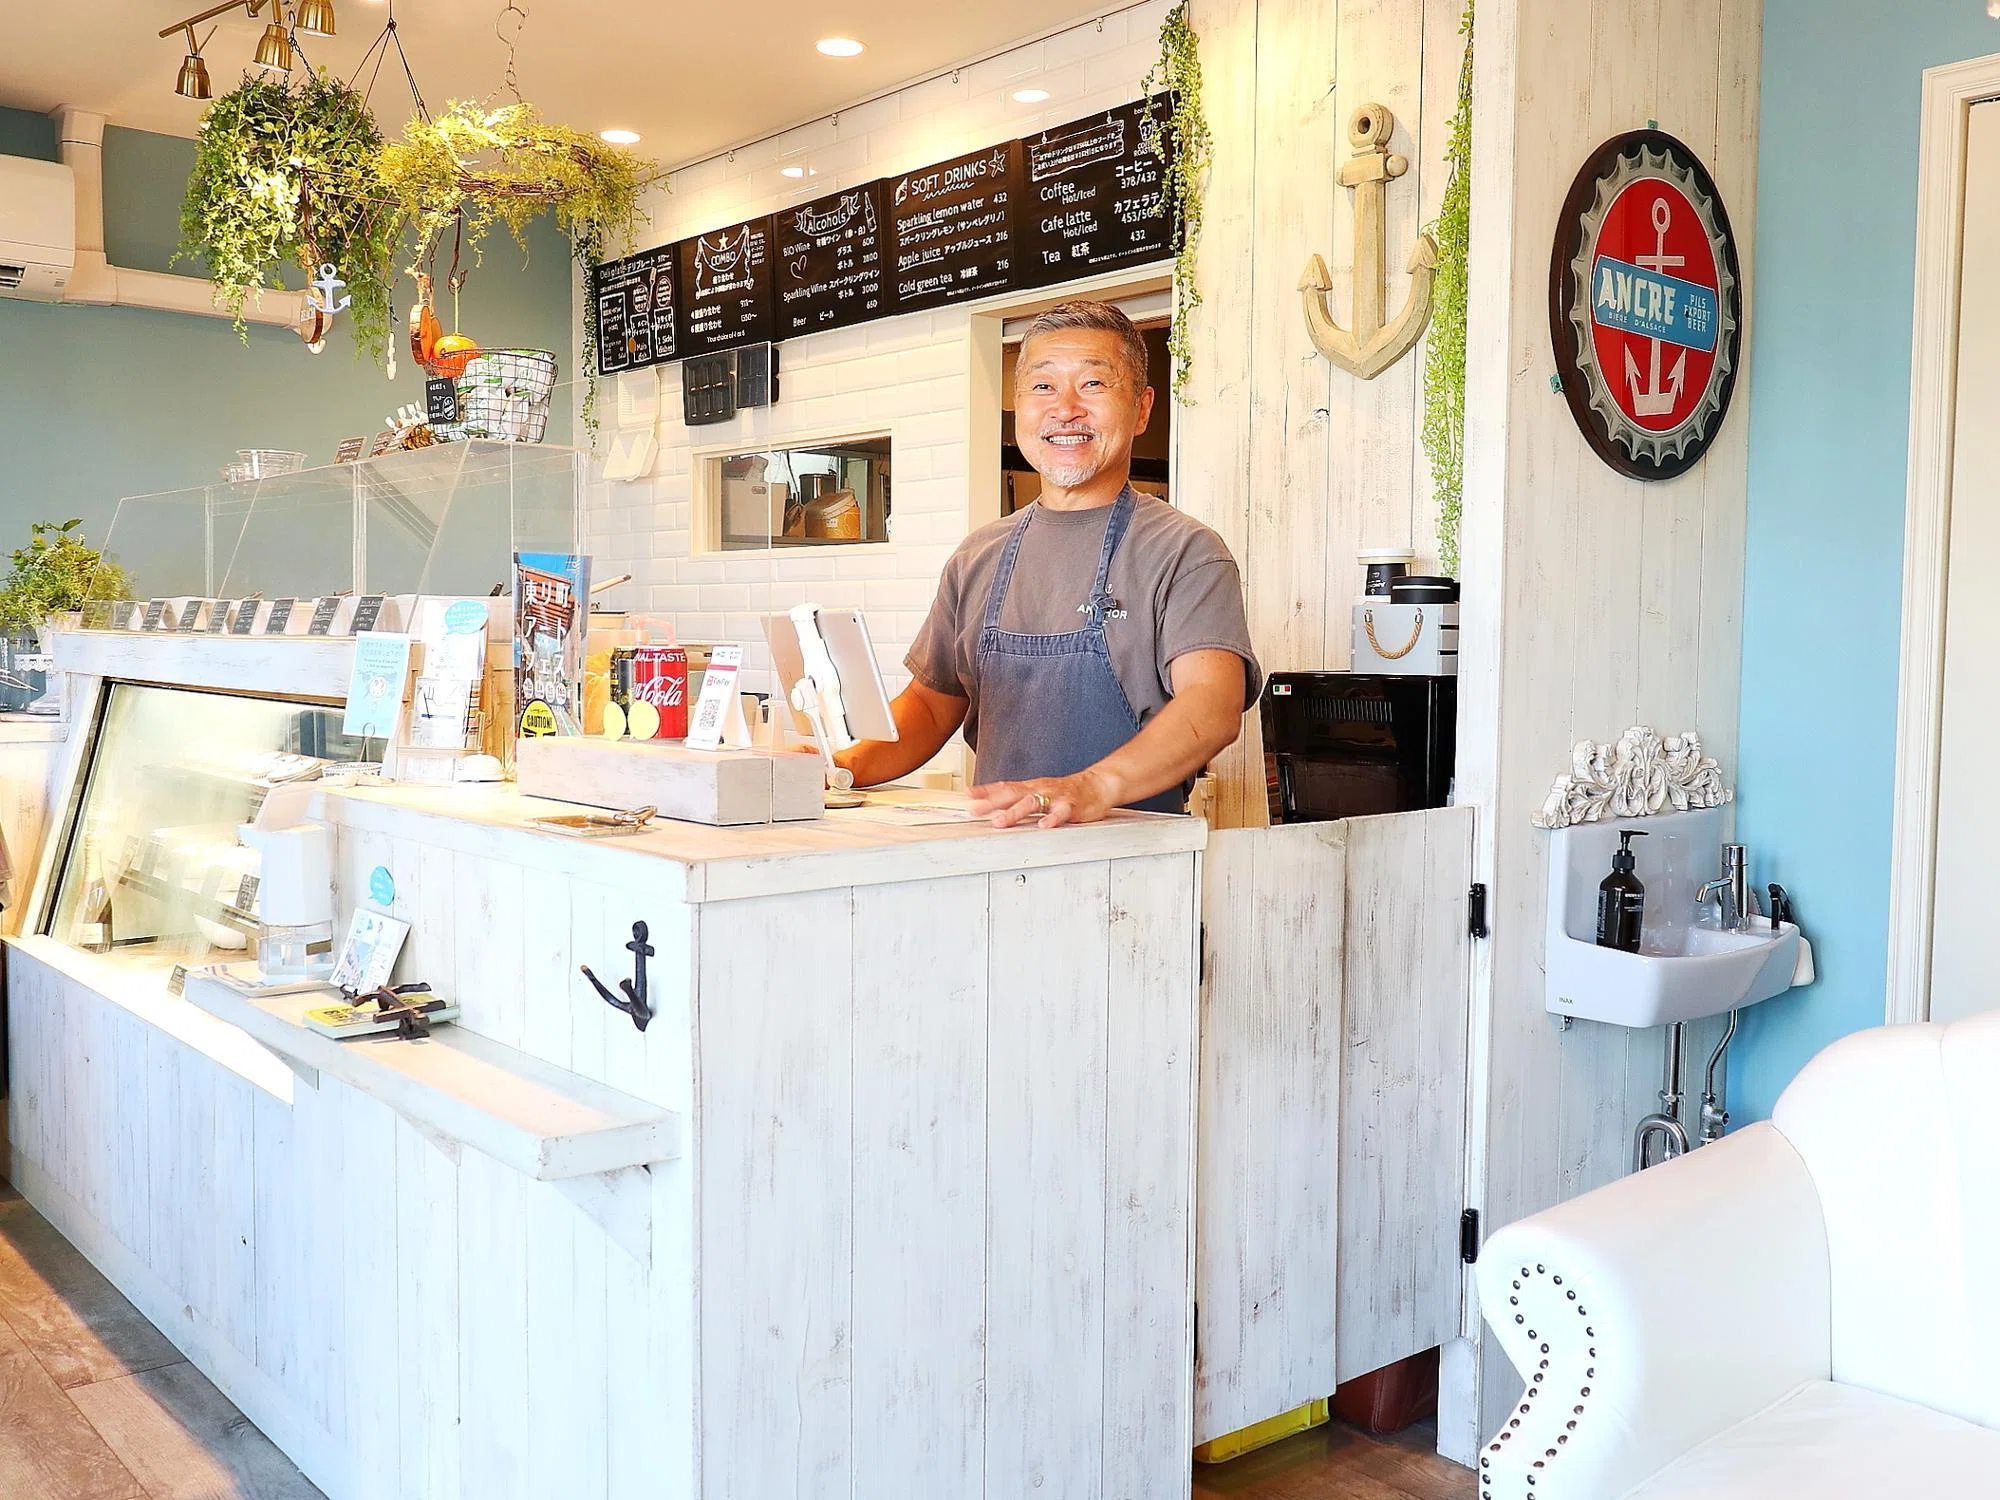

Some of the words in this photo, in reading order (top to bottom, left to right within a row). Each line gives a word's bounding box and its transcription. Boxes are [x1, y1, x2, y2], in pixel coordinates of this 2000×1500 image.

[911, 174, 940, 195] SOFT
[945, 160, 987, 186] DRINKS
[1041, 182, 1075, 201] Coffee
[1115, 160, 1152, 178] コーヒー
[1062, 186, 1096, 205] Hot/Iced
[1121, 171, 1157, 189] 378/432
[808, 211, 847, 233] Alcohols
[897, 213, 932, 232] Sparkling
[933, 205, 959, 220] lemon
[960, 198, 984, 213] water
[993, 192, 1008, 204] 432
[1041, 216, 1064, 233] Cafe
[1066, 211, 1091, 226] latte
[1114, 192, 1160, 214] カフェラテ
[1063, 220, 1098, 239] Hot/Iced
[783, 246, 795, 257] BIO
[795, 242, 811, 255] Wine
[837, 245, 852, 256] グラス
[863, 237, 874, 247] 600
[898, 251, 920, 267] Apple
[922, 247, 941, 263] juice
[944, 235, 992, 254] アップルジュース
[996, 231, 1008, 242] 216
[1042, 251, 1061, 264] Tea
[1072, 242, 1090, 257] 紅茶
[1130, 230, 1146, 242] 432
[711, 251, 736, 267] COMBO
[837, 259, 854, 270] ボトル
[783, 288, 811, 303] Sparkling
[811, 283, 827, 294] Wine
[829, 270, 880, 289] スパークリングワイン
[899, 280, 916, 294] Cold
[917, 277, 939, 292] green
[940, 274, 953, 284] tea
[997, 259, 1009, 270] 216
[838, 289, 854, 299] ボトル
[862, 283, 878, 294] 3000
[1598, 267, 1676, 326] ANCRE
[1690, 295, 1706, 309] PILS
[793, 317, 807, 327] Beer
[820, 311, 834, 321] ビール
[1609, 312, 1628, 323] BIERE
[1635, 320, 1666, 334] D'ALSACE
[1688, 318, 1706, 333] BEER
[525, 615, 567, 651] アート
[523, 651, 566, 679] フェス
[653, 653, 686, 662] TASTE
[527, 715, 552, 729] CAUTION!
